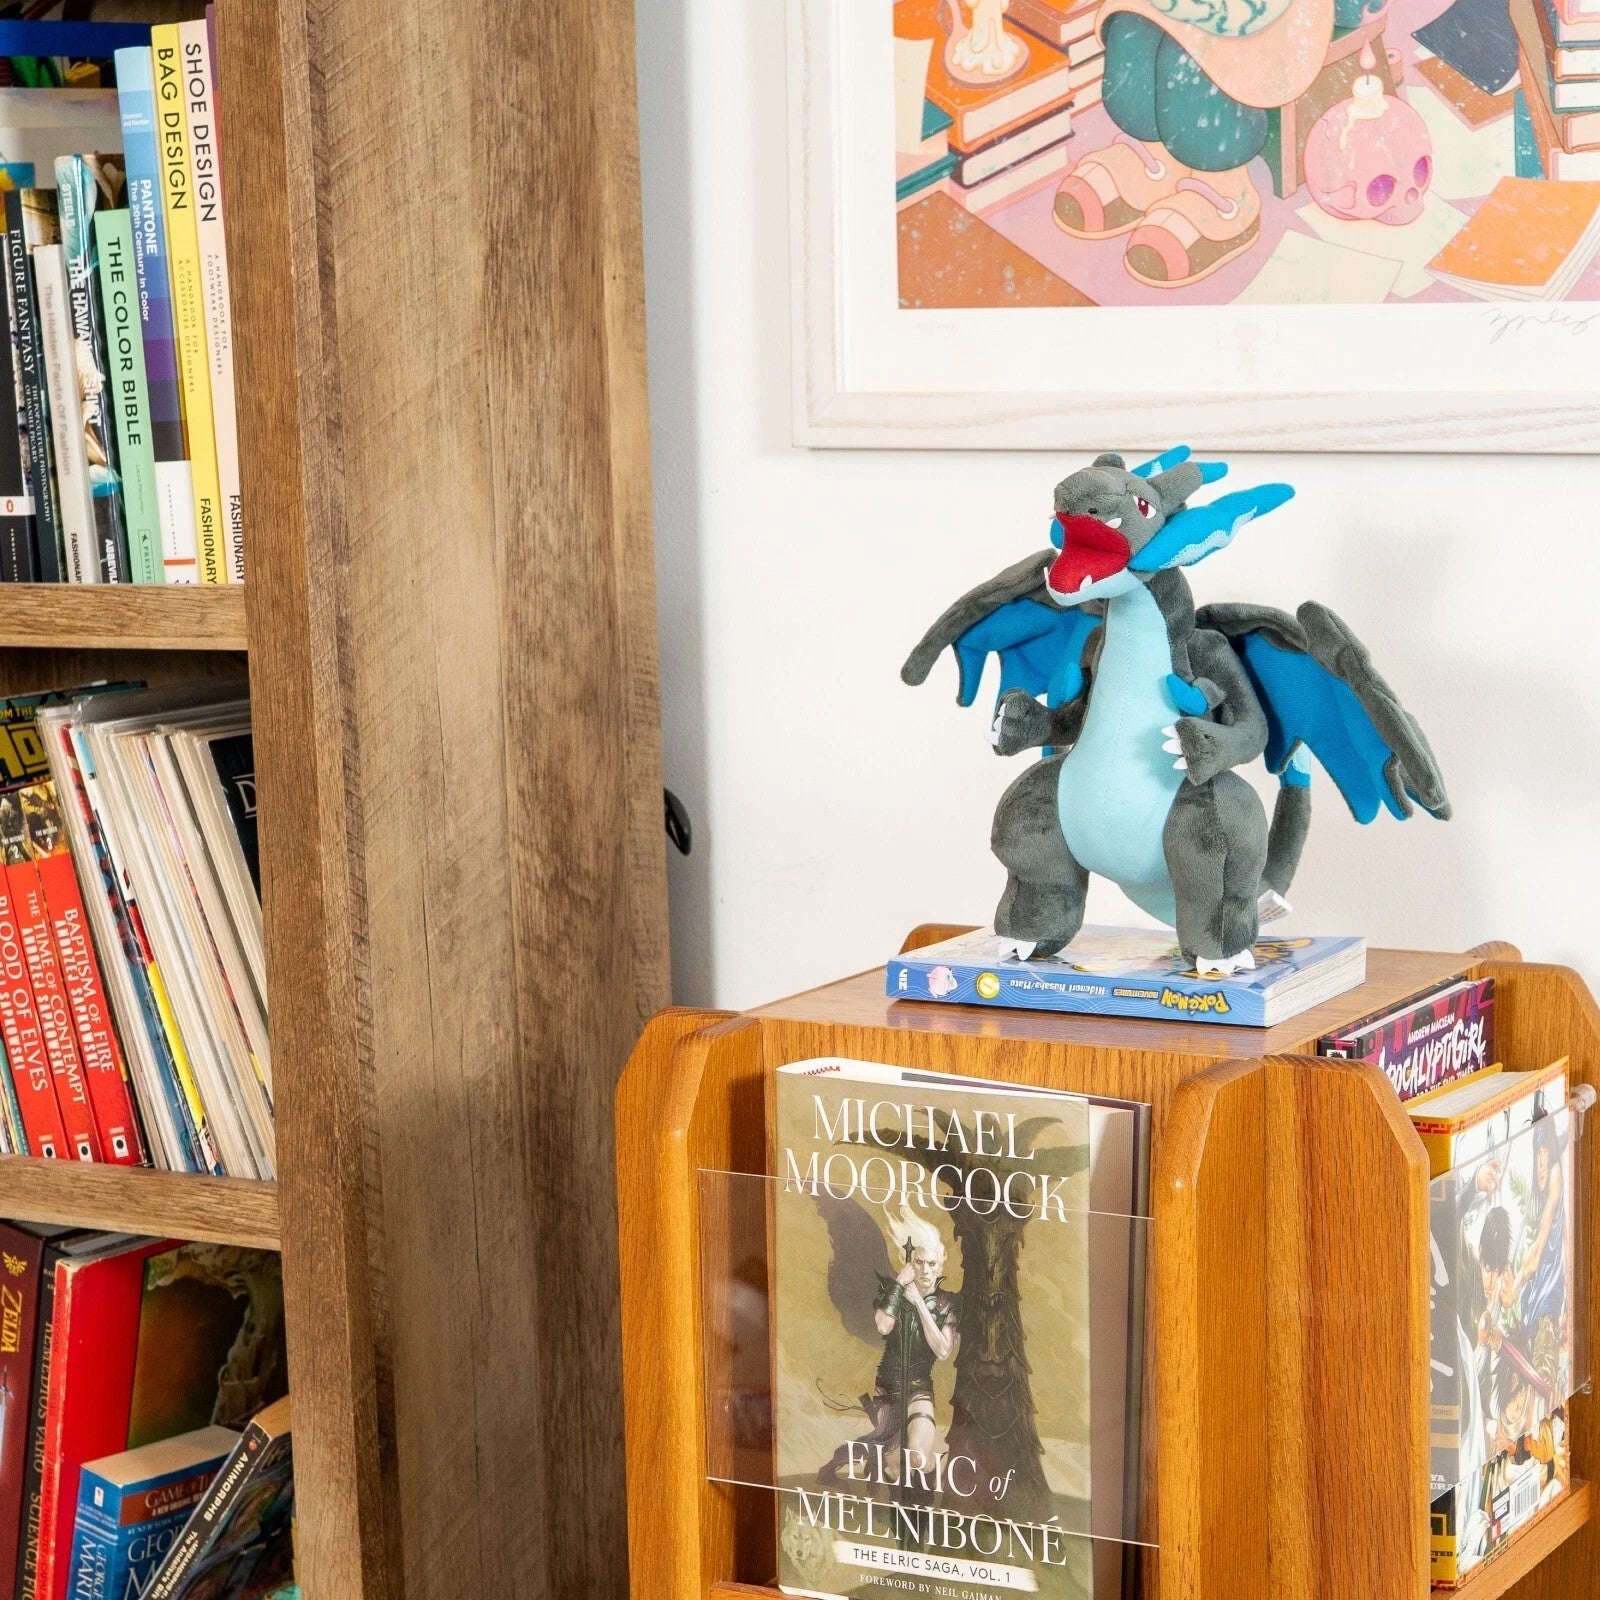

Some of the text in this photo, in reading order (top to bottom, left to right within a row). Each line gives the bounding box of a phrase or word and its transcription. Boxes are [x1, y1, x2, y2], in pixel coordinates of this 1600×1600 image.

[158, 48, 188, 210] BAG DESIGN
[185, 43, 216, 222] SHOE DESIGN
[130, 180, 150, 322] The 20th Century in Color
[140, 179, 158, 255] PANTONE
[11, 229, 34, 374] FIGURE FANTASY
[69, 254, 86, 290] THE
[187, 270, 196, 329] HANDBOOK
[216, 266, 226, 325] HANDBOOK
[108, 237, 141, 446] THE COLOR BIBLE
[208, 254, 222, 375] FOOTWEAR DESIGNERS
[44, 282, 72, 476] The Hidden Facts Of Fashion
[184, 336, 194, 393] DESIGNERS
[24, 384, 38, 463] OF DANIEL PICARD
[36, 418, 44, 458] CULTURE
[40, 460, 50, 522] PHOTOGRAPHY
[70, 532, 82, 584] FASHIONAR
[200, 498, 217, 584] FASHIONARY
[229, 495, 245, 581] FASHIONARY
[16, 706, 34, 716] THE
[13, 845, 20, 859] 2
[46, 836, 53, 850] 3
[12, 988, 32, 1020] OF
[22, 928, 66, 1075] ANDRZEJ SAPKOWSKI
[27, 889, 86, 1105] THE TIME OF CONTEMPT
[54, 920, 100, 1068] ANDRZEJ SAPKOWSKI
[64, 908, 116, 1074] BAPTISM OF FIRE
[898, 968, 908, 990] VIZ
[1068, 984, 1106, 996] Hidenori
[20, 1027, 48, 1092] ELVES
[1407, 1012, 1455, 1046] ANDREW MACLEAN
[811, 1094, 1036, 1160] MICHAEL
[783, 1147, 1071, 1224] MOORCOCK
[1, 1284, 22, 1353] ZELDA
[34, 1426, 46, 1473] VARO
[844, 1440, 1016, 1501] ELRIC of
[204, 1452, 248, 1522] ANIMORPHS
[24, 1492, 41, 1571] SCIENCE
[186, 1530, 198, 1545] The
[796, 1486, 1067, 1566] MELNIBONÉ
[151, 1583, 164, 1600] Gift
[854, 1548, 1010, 1583] THE ELRIC SAGA, VOL. 1
[860, 1574, 1002, 1600] FOREWORD BY NEIL GAIMAN
